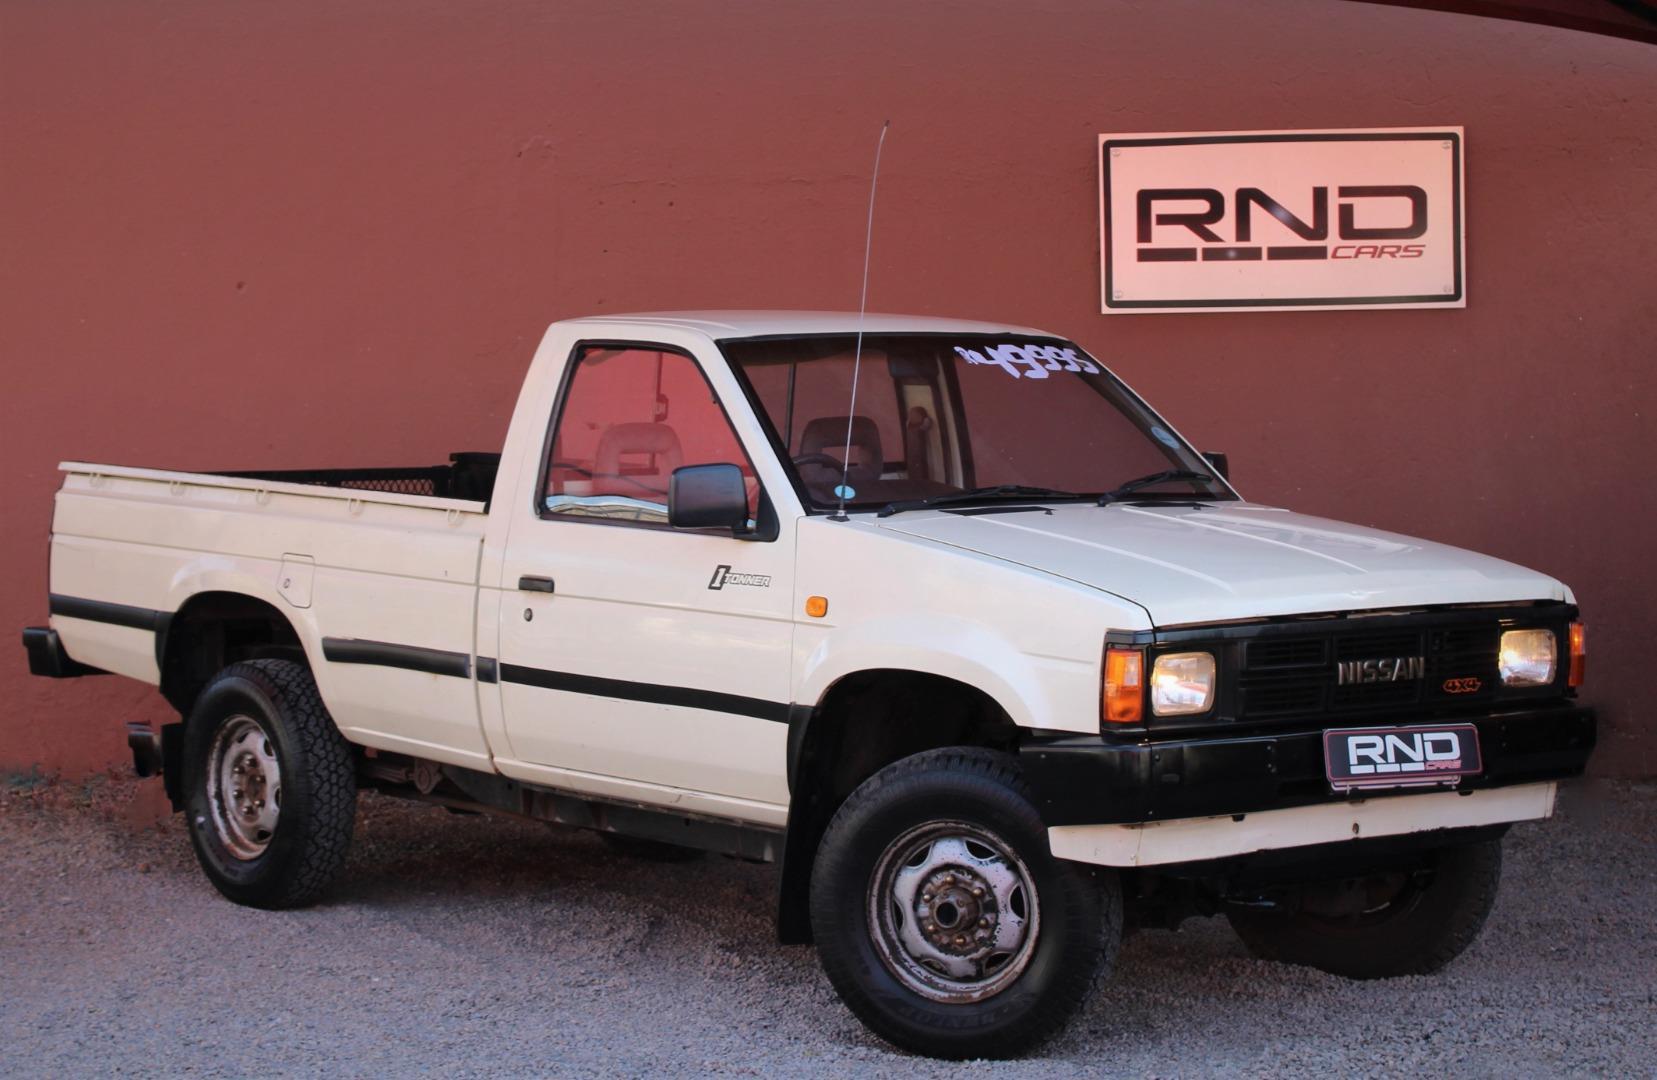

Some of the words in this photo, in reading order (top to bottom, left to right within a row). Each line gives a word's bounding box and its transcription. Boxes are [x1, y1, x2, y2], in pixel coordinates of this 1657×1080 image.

[1136, 185, 1428, 242] RND
[1331, 244, 1426, 260] CARS
[725, 573, 771, 587] TONNER
[1338, 656, 1425, 686] NISSAN
[1348, 732, 1462, 766] RND
